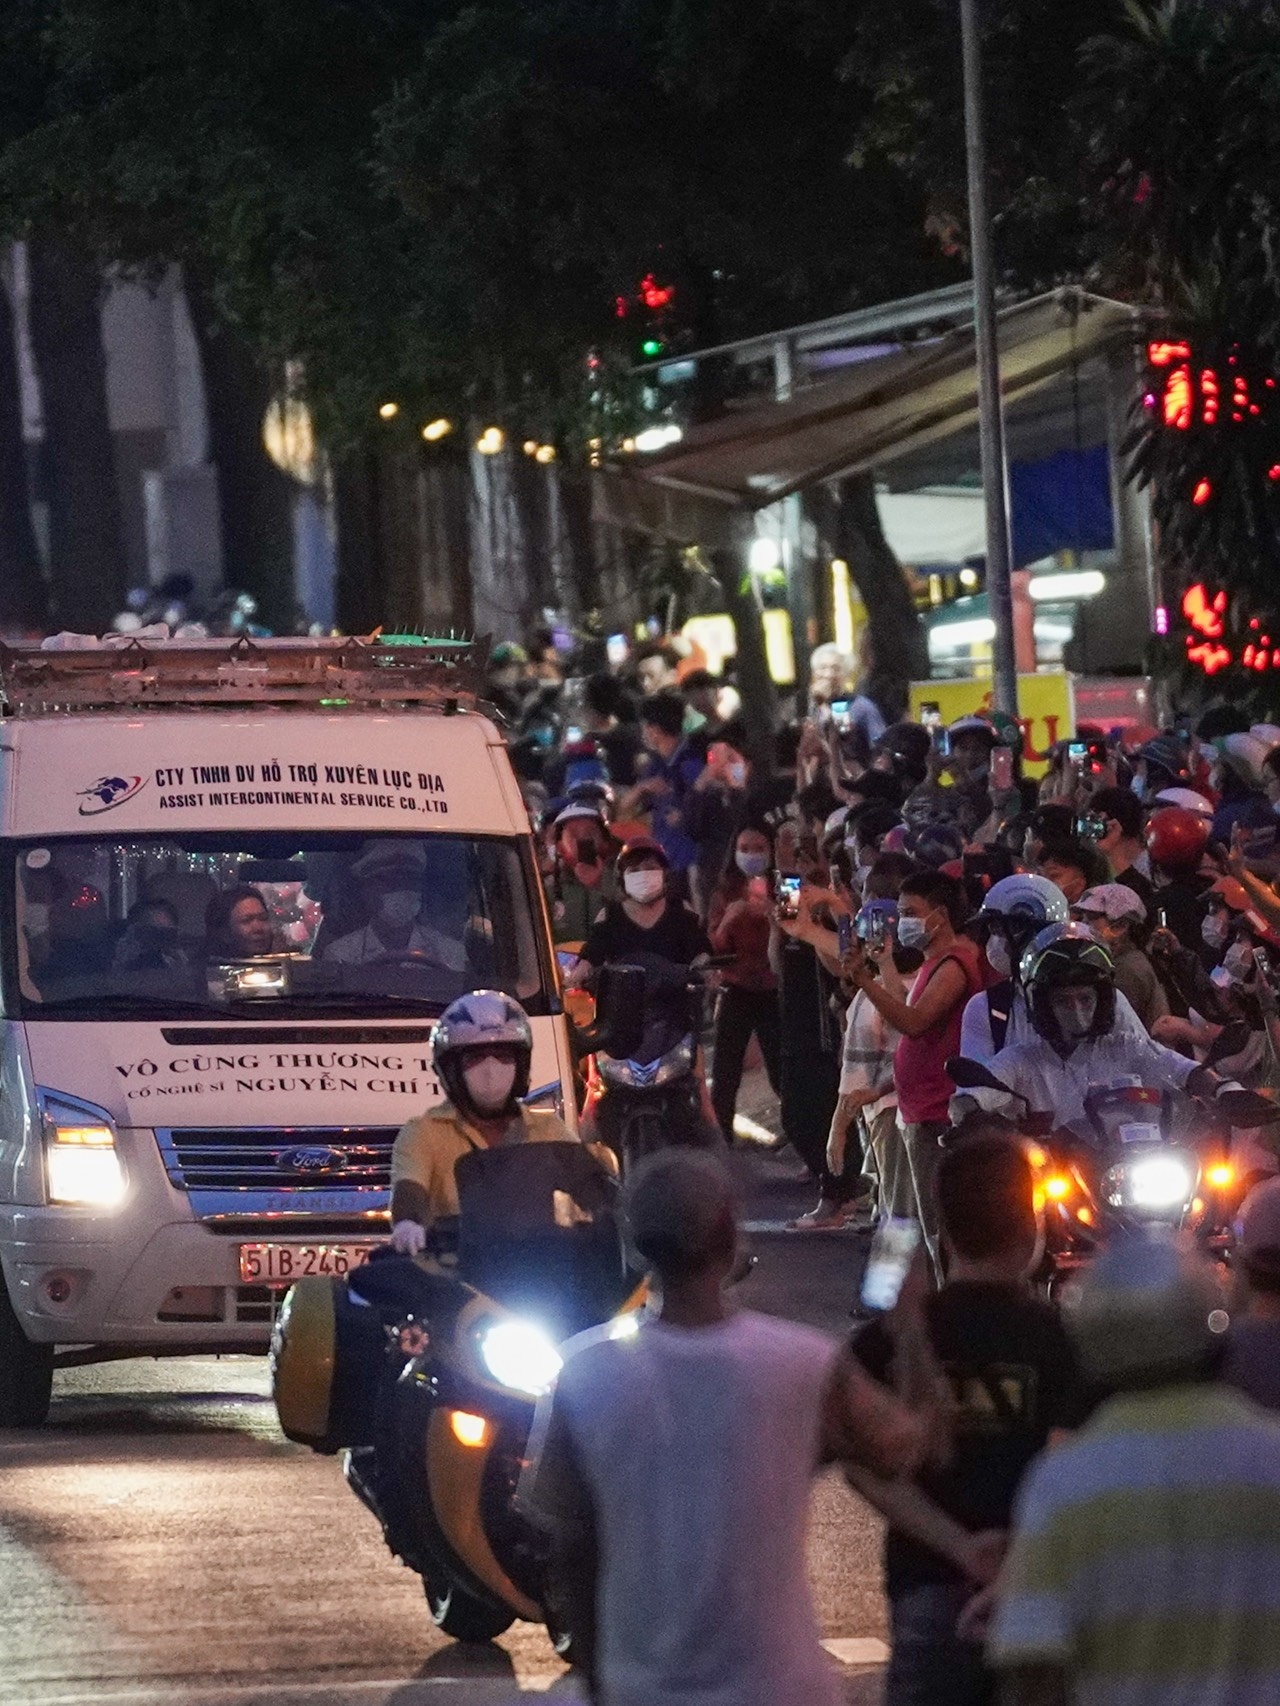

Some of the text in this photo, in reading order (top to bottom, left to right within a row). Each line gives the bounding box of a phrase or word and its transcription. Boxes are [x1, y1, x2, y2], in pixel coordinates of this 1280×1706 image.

[155, 758, 445, 794] CTY TNHH DV HỖ TRỢ XUYÊN LỤC ĐỊA
[159, 791, 448, 814] ASSIST INTERCONTINENTAL SERVICE CO.,LTD
[115, 1058, 159, 1079] VÔ
[168, 1054, 260, 1074] CÙNG
[269, 1052, 403, 1071] THƯƠNG
[235, 1072, 358, 1093] NGUYỄN
[366, 1077, 419, 1095] CHÍ
[292, 1152, 331, 1168] Ford
